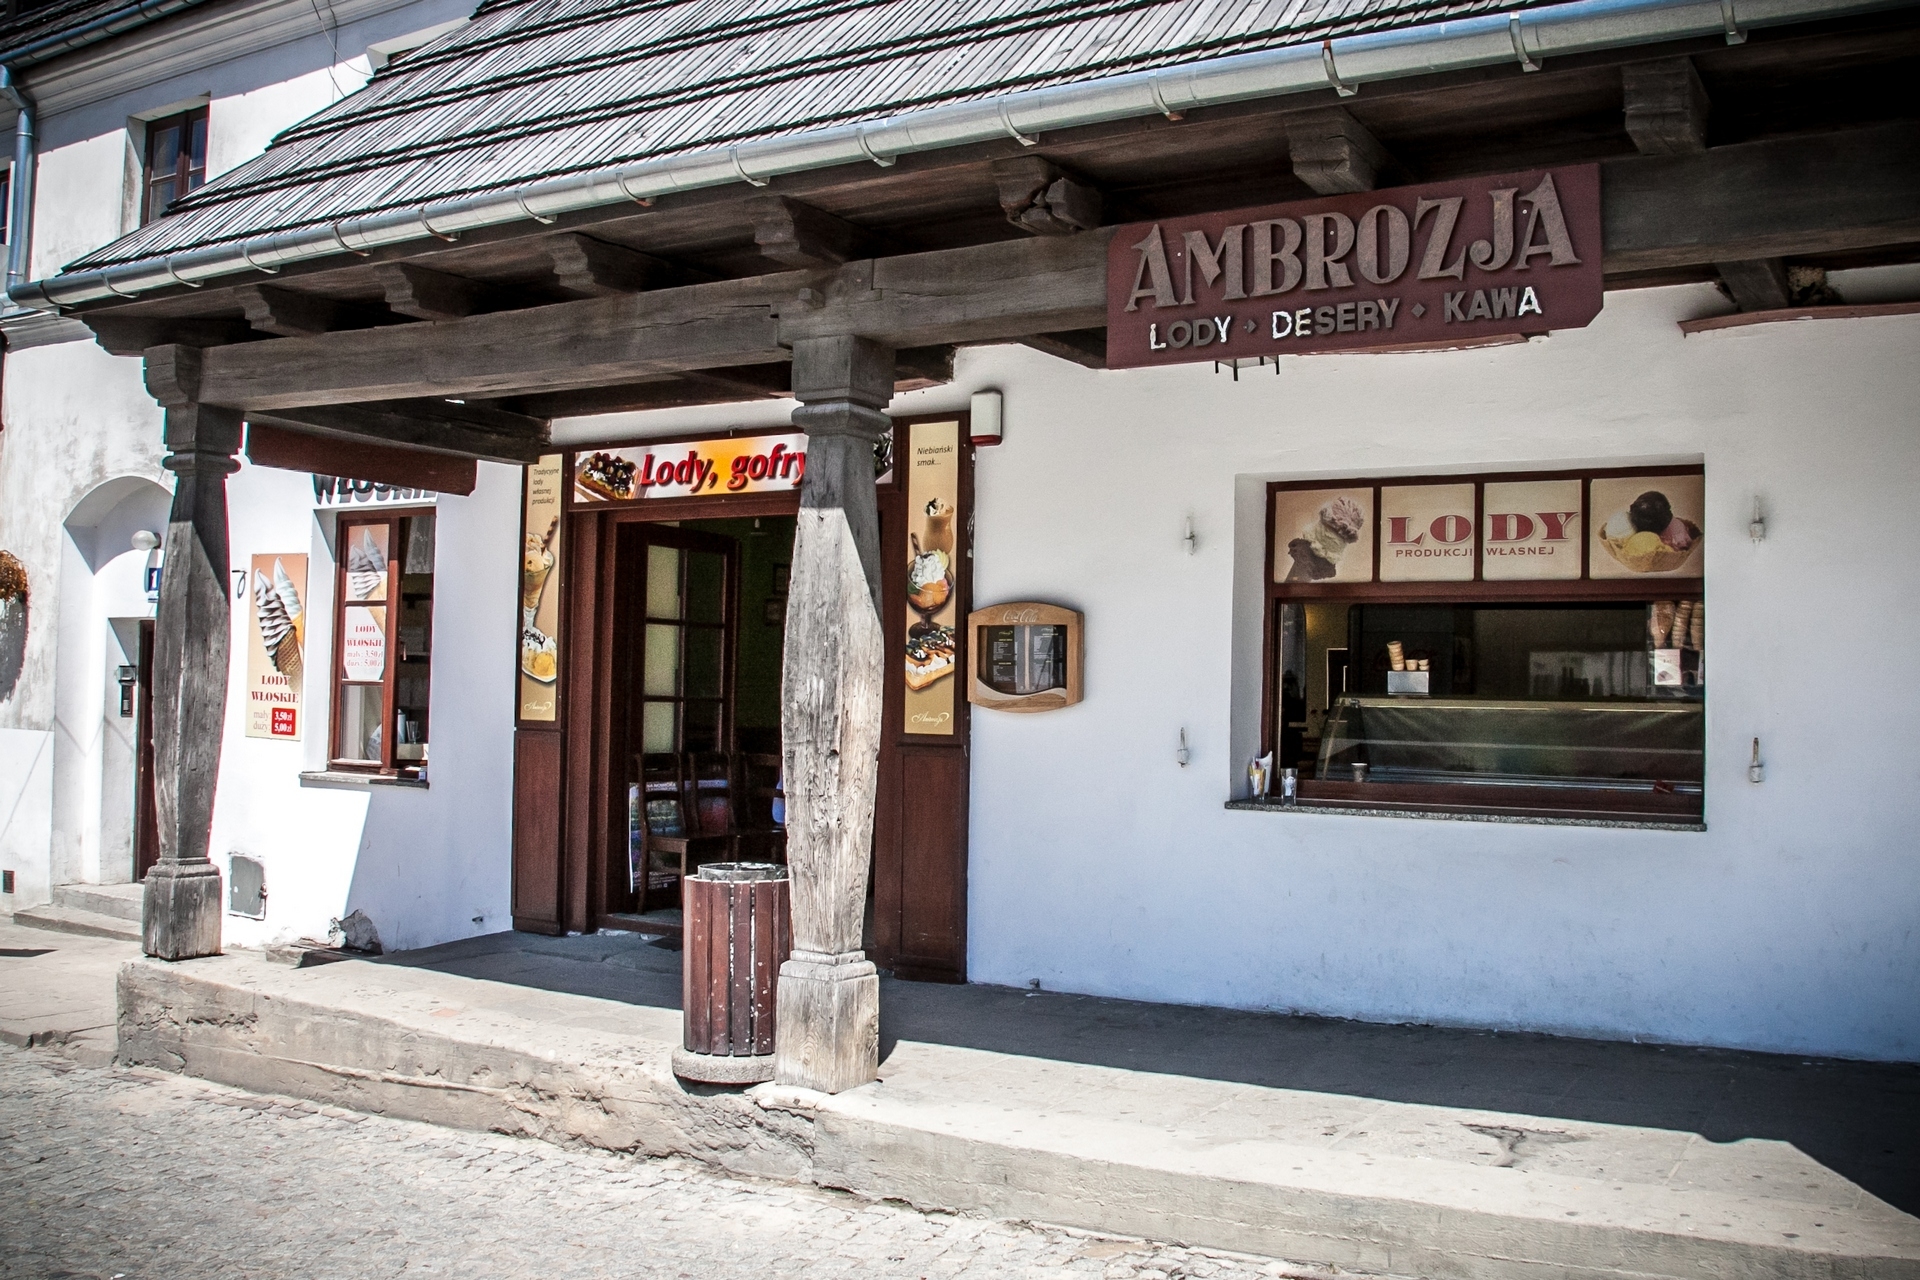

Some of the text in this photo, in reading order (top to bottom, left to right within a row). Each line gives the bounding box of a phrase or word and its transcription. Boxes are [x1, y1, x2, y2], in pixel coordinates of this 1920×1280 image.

[1123, 171, 1582, 312] AMBROZJA
[1149, 286, 1543, 350] LODY DESERY KAWA
[916, 445, 954, 455] Niebiański
[640, 450, 718, 493] Lody,
[1386, 511, 1580, 547] LODY
[1395, 546, 1555, 558] PRODUKCJI WŁASNEJ
[354, 625, 377, 634] LODY
[261, 674, 291, 686] LODY
[251, 690, 299, 703] WŁOSKIE
